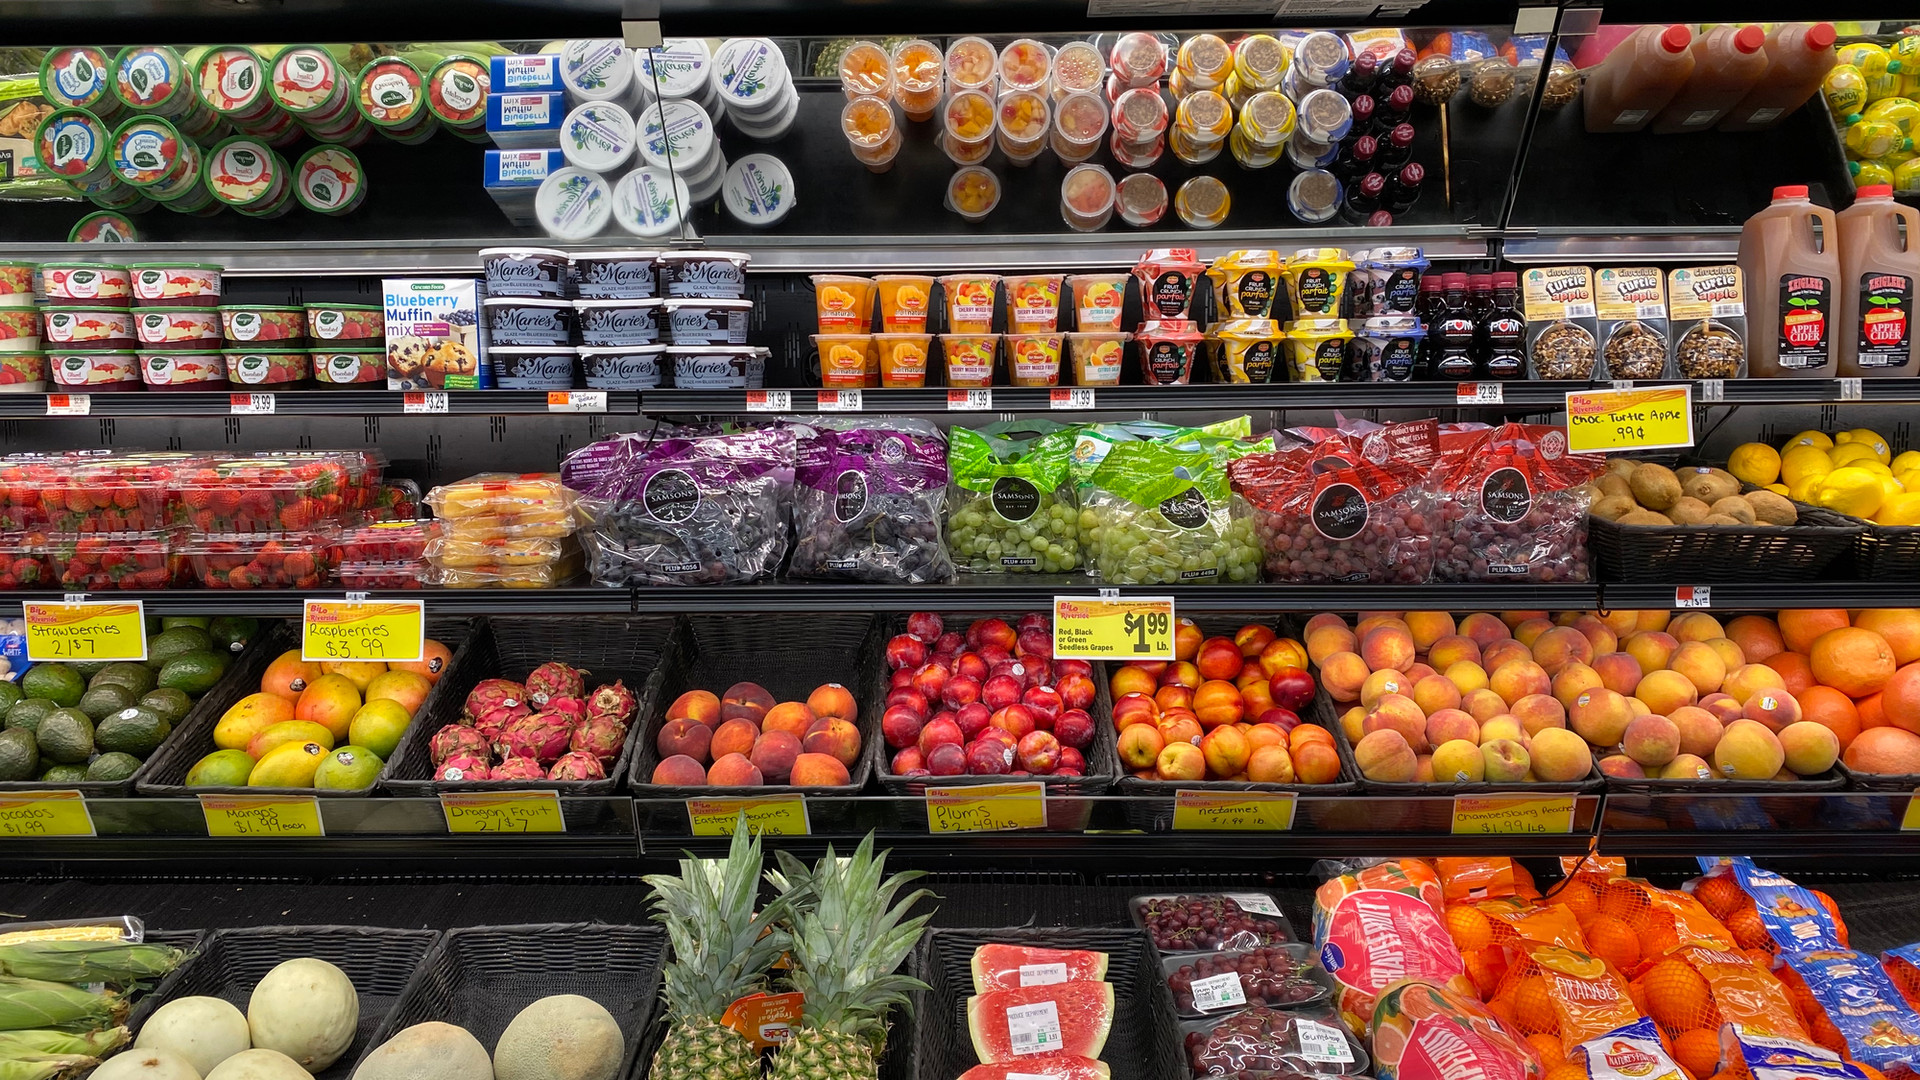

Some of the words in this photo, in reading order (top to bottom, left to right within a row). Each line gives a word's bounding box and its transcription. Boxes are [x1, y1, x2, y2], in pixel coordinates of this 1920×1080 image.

[491, 260, 536, 281] Marie's
[600, 264, 648, 285] Marie's
[692, 264, 740, 284] Marie's
[1547, 268, 1586, 277] Chocolate
[1618, 268, 1657, 277] Chocolate
[1694, 267, 1736, 277] Chocolate
[1546, 275, 1586, 294] turtle
[1618, 275, 1656, 295] turtle
[1693, 275, 1736, 295] turtle
[1156, 293, 1185, 302] parfait
[1241, 291, 1268, 299] parfait
[1301, 287, 1329, 297] parfait
[1552, 290, 1588, 302] apple
[1623, 290, 1659, 303] apple
[1698, 289, 1738, 302] apple
[386, 294, 458, 308] Blueberry
[386, 308, 432, 320] Muffin
[503, 310, 552, 332] Marie's
[598, 312, 646, 332] Marie's
[1871, 323, 1901, 332] APPLE
[388, 324, 412, 336] mix
[1790, 324, 1819, 334] APPLE
[1790, 333, 1820, 341] CIDER
[1870, 332, 1901, 340] CIDER
[526, 359, 572, 380] Marie's
[605, 358, 652, 379] Marie's
[680, 359, 728, 379] Marie's
[1152, 362, 1179, 370] parfait
[969, 391, 987, 406] $1.99
[1072, 390, 1090, 405] $1.99
[1479, 386, 1498, 398] $2.99
[252, 394, 271, 410] $3.99
[426, 394, 445, 410] $3.29
[768, 392, 787, 407] $1.99
[840, 392, 858, 407] $1.99
[1573, 404, 1604, 414] Riverside
[1608, 412, 1645, 422] Turtle
[1650, 410, 1681, 420] Apple
[651, 490, 693, 502] SAMSONS
[1487, 492, 1524, 500] SAMSONS
[1319, 505, 1361, 518] SAMSONS
[1060, 603, 1078, 612] BiLo
[32, 624, 120, 637] Strawberries
[310, 623, 389, 638] Raspberries
[326, 638, 384, 658] $3.99
[1156, 642, 1169, 650] Lb.
[226, 808, 278, 819] Mangos
[451, 807, 506, 819] Dragon
[510, 805, 552, 816] Fruit
[936, 806, 991, 820] Plums
[1199, 806, 1258, 815] nectarines
[1456, 809, 1538, 821] Chambersburg
[4, 820, 45, 834] $1.99
[234, 817, 281, 833] $1.99
[694, 816, 738, 825] Eastern
[1481, 820, 1524, 833] $1.99
[1358, 901, 1406, 988] GRAPEFRUIT
[1556, 976, 1619, 1000] ORANGES
[765, 1006, 785, 1014] Gold
[758, 1011, 794, 1023] Tropical
[764, 1030, 789, 1039] Dole
